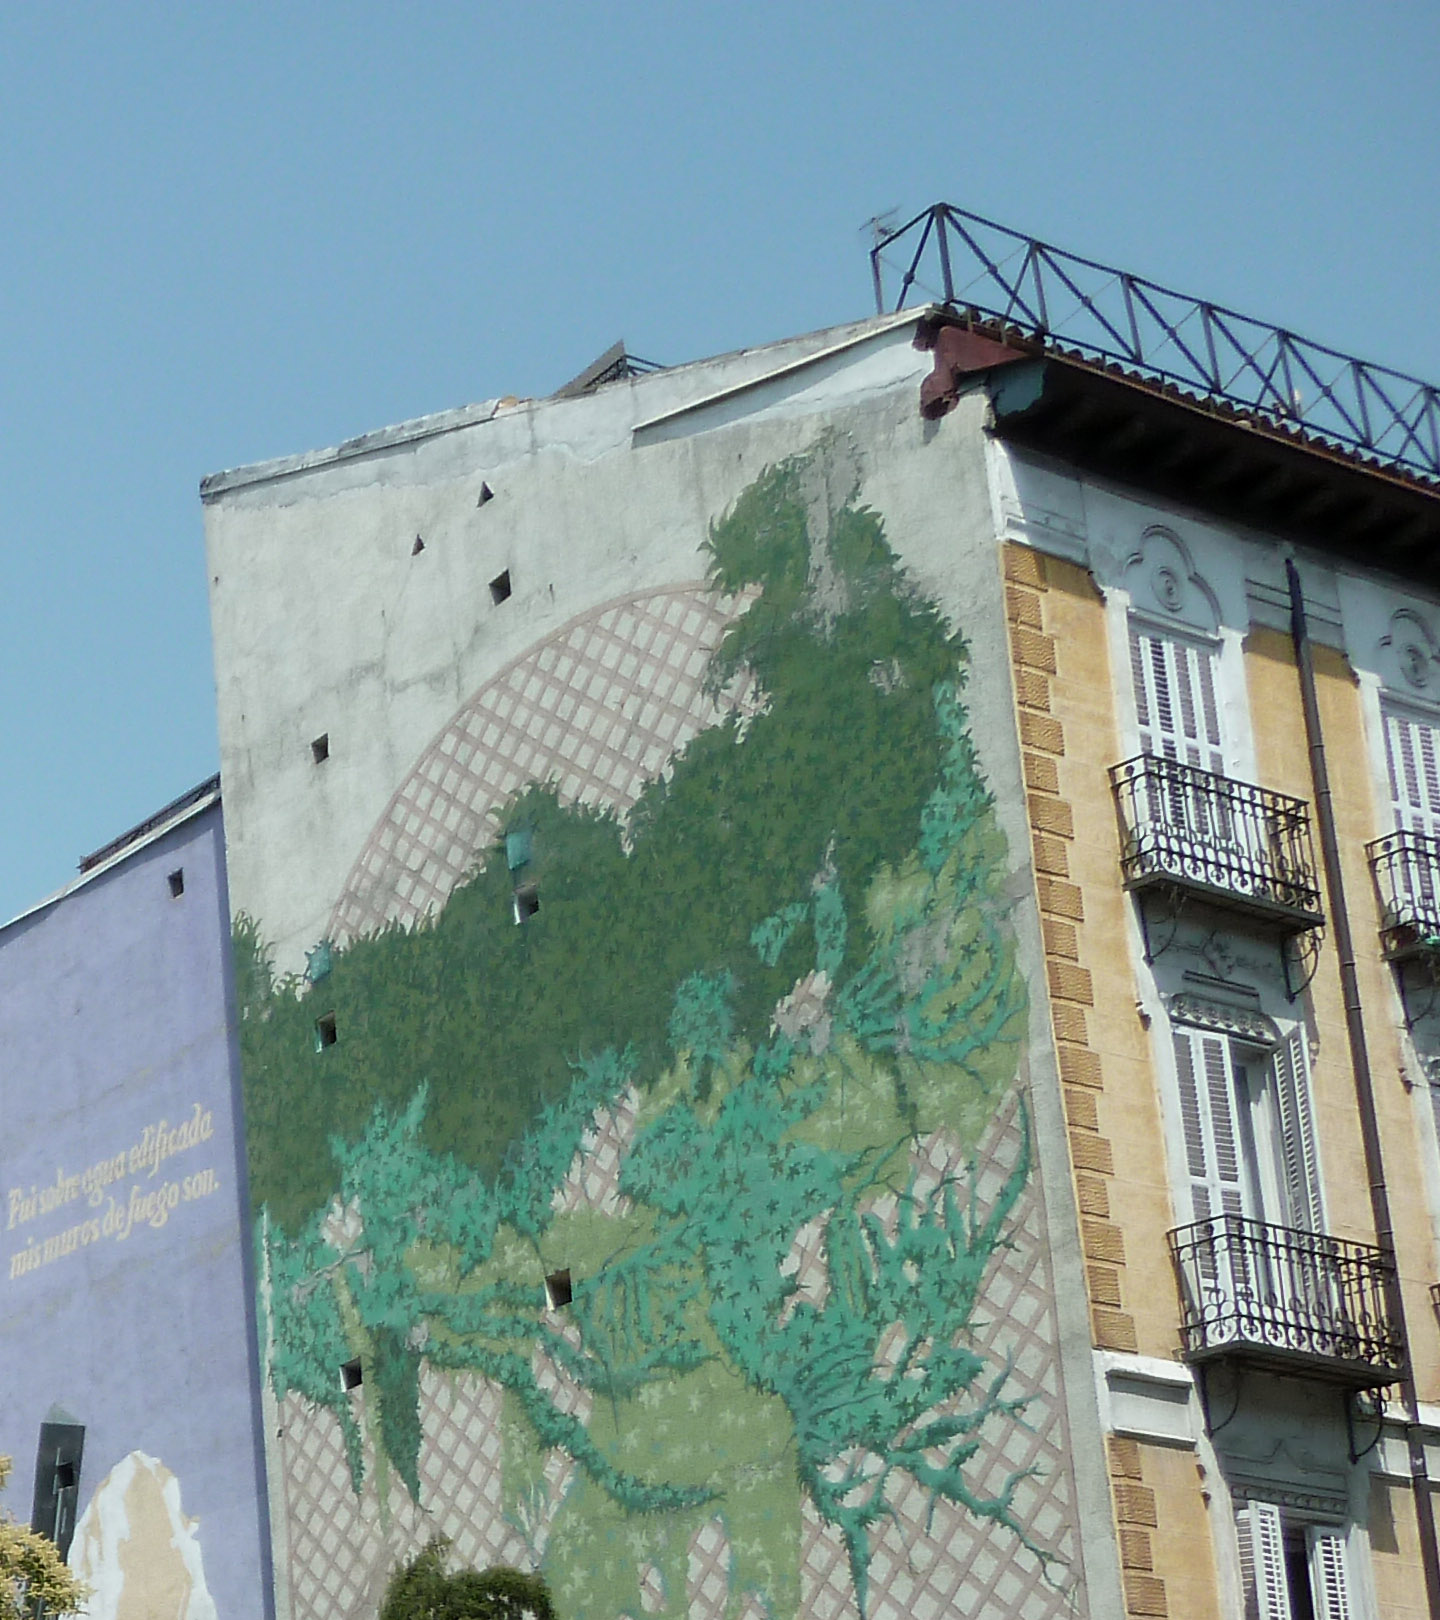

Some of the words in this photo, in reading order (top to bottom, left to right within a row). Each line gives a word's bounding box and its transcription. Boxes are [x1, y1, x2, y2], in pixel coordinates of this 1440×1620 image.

[7, 1186, 37, 1231] Fui
[40, 1167, 81, 1215] sobre
[82, 1151, 127, 1208] agua
[129, 1103, 214, 1179] edificada
[9, 1236, 42, 1280] mis
[43, 1218, 100, 1264] muros
[102, 1196, 124, 1238] de
[116, 1184, 179, 1242] fuego
[182, 1168, 220, 1202] son.
